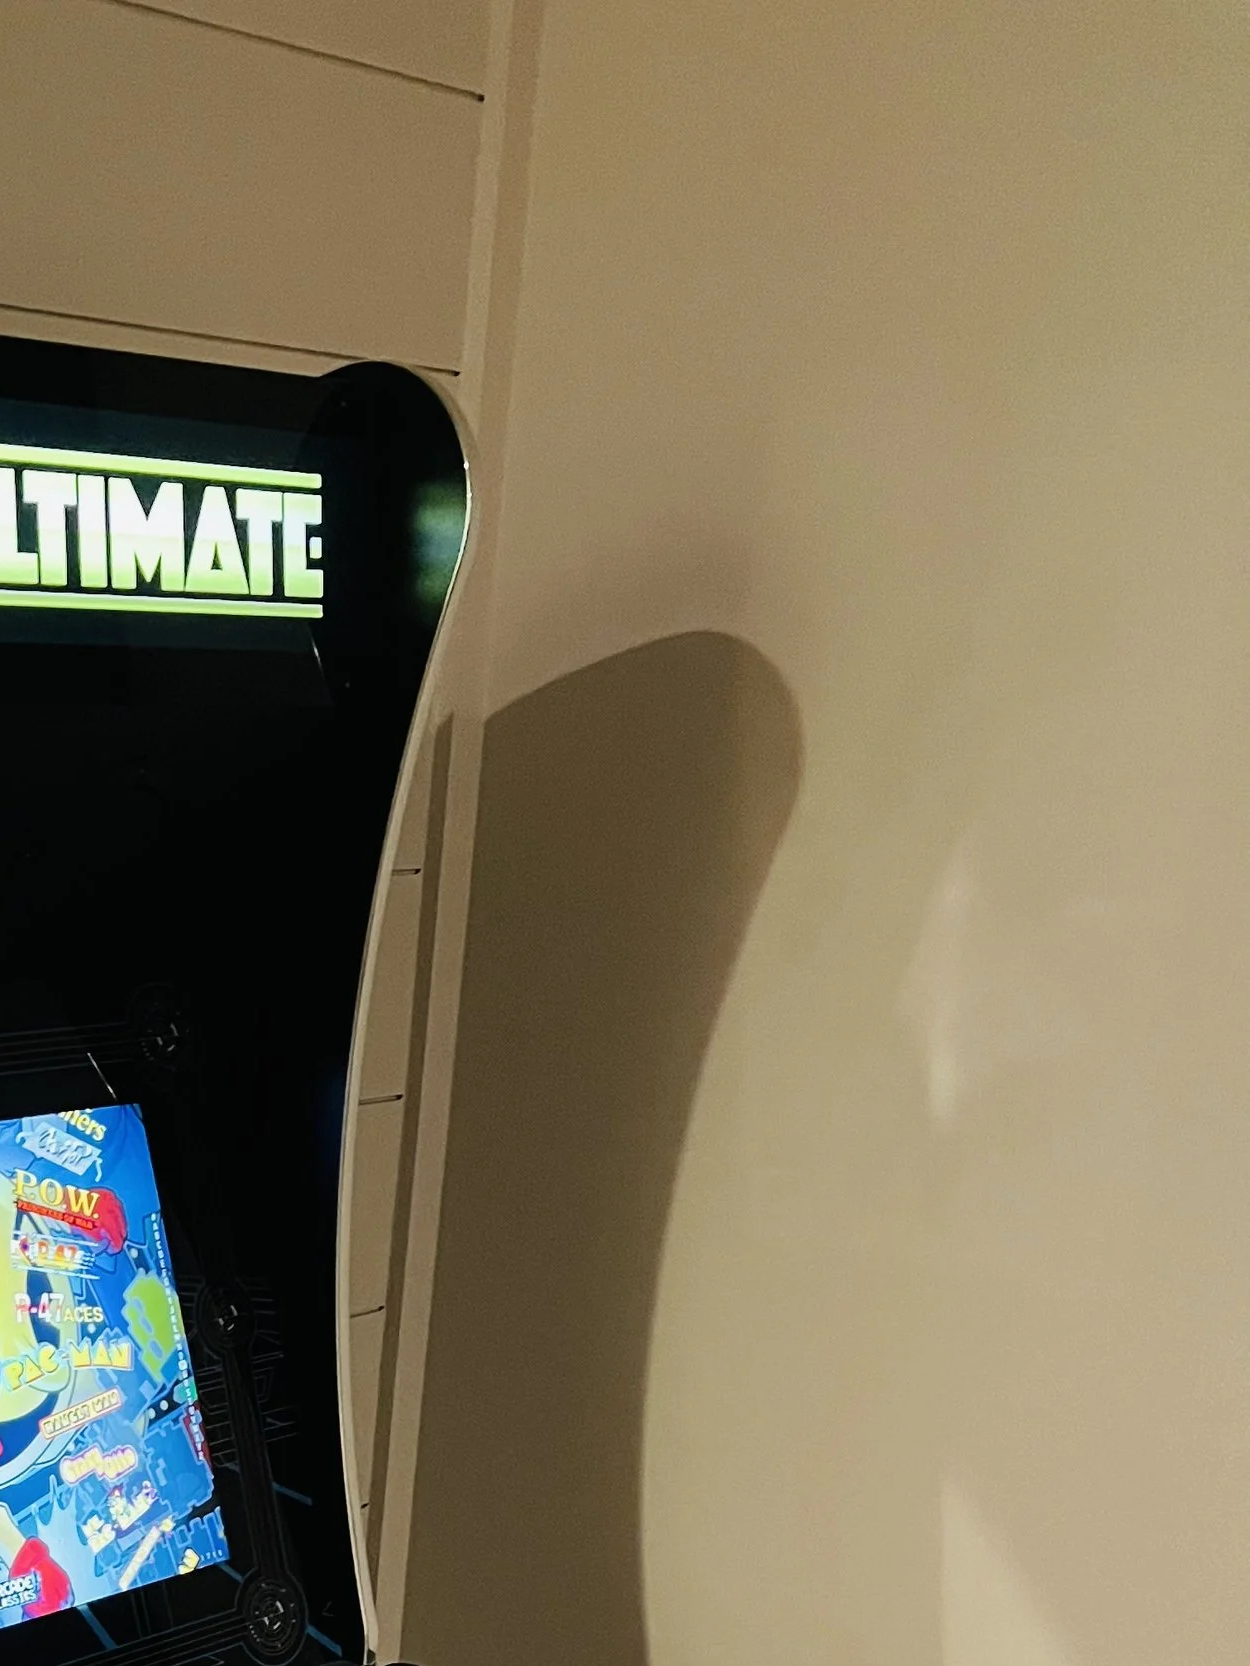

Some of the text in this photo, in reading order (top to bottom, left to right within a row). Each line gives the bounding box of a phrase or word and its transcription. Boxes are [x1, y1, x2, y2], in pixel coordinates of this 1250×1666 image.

[14, 1292, 104, 1323] P-47 ACES
[3, 1336, 134, 1391] PAC-MAN
